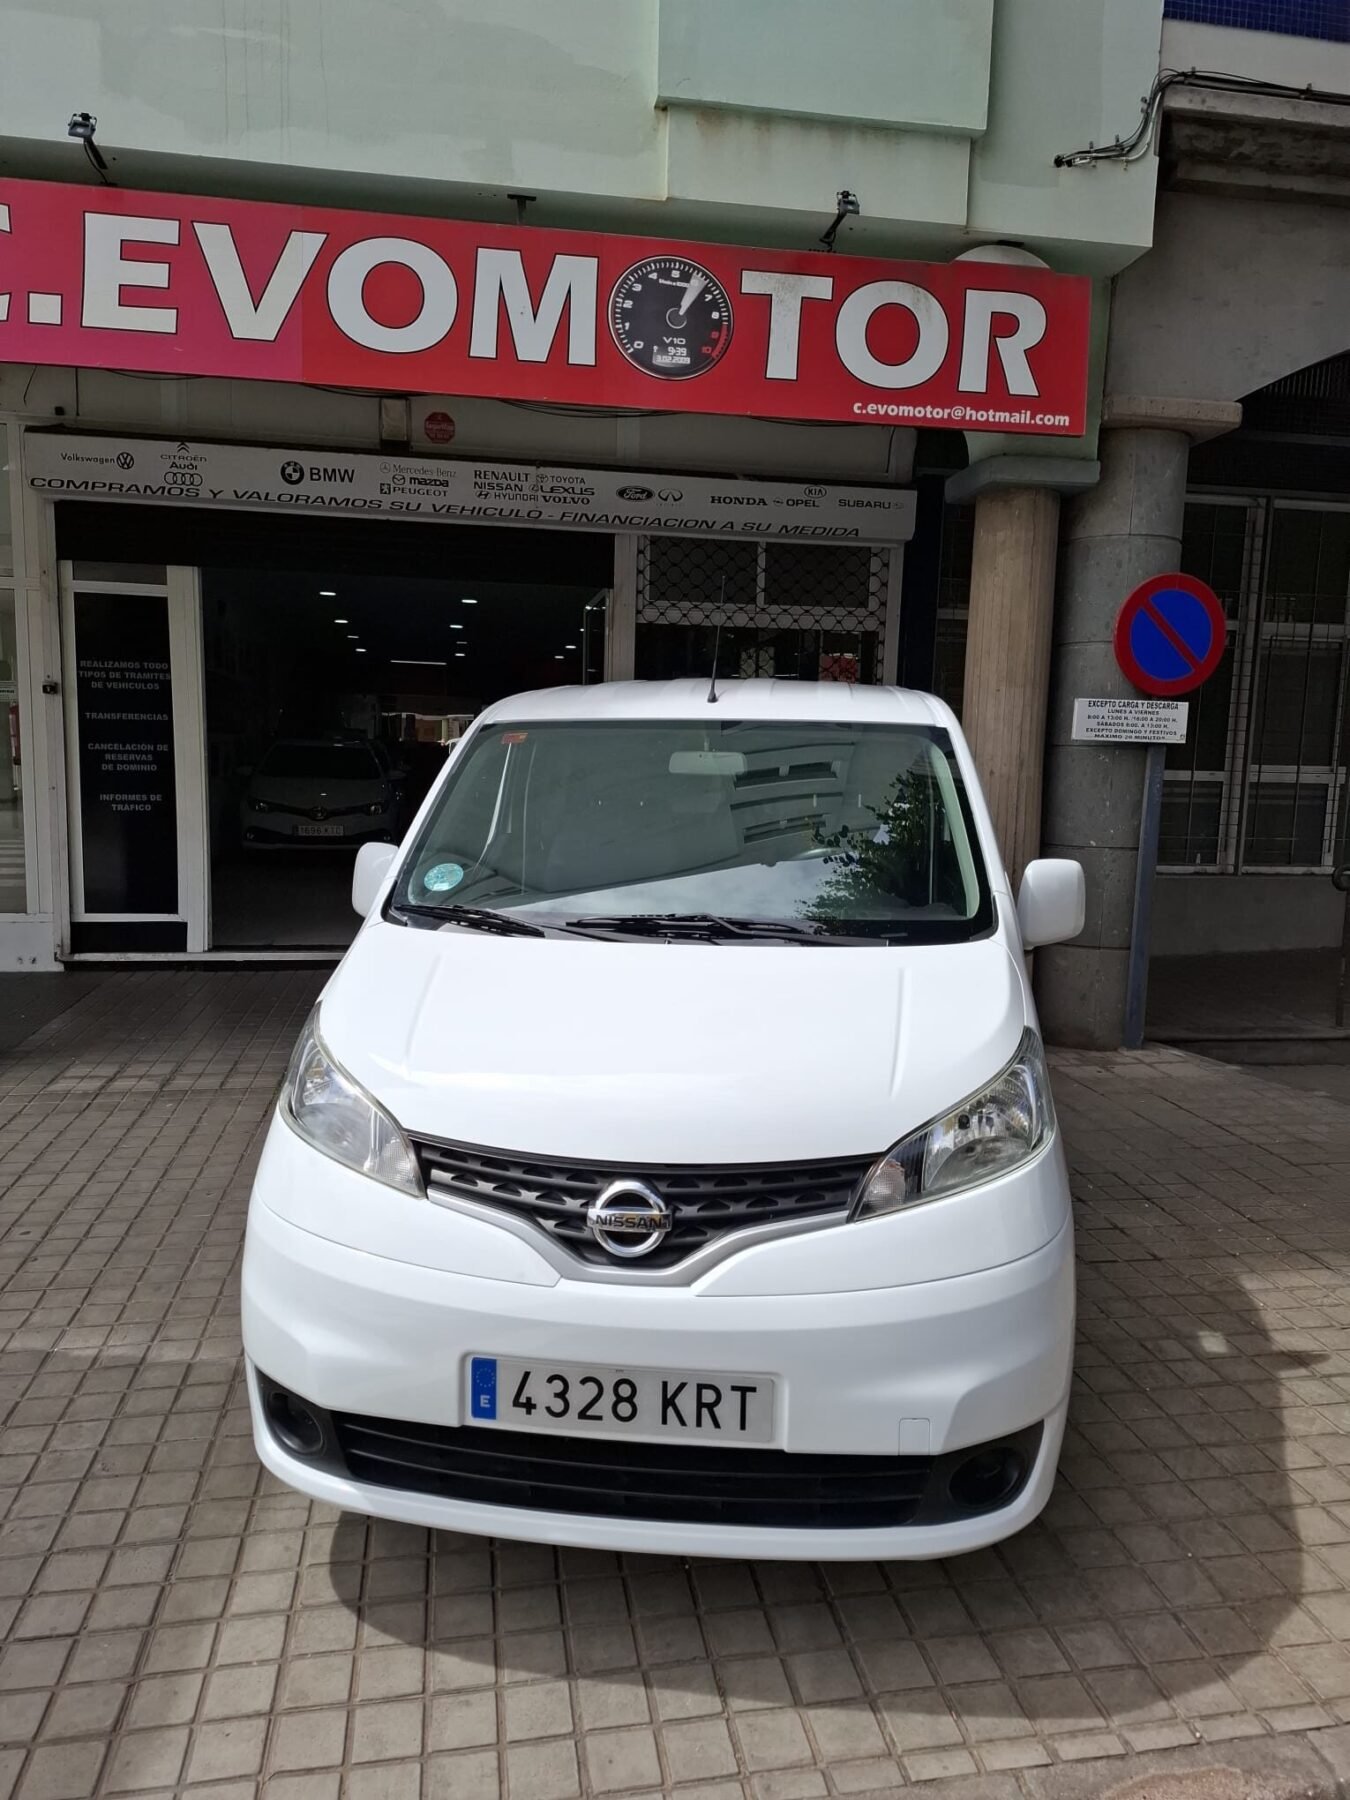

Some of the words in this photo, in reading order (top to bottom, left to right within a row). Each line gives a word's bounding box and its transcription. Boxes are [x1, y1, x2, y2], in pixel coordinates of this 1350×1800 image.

[632, 284, 642, 292] 3
[623, 300, 633, 308] 2
[633, 341, 644, 349] 0
[662, 336, 686, 345] V10
[853, 401, 1070, 427] c.evomotor@hotmail.com
[61, 452, 115, 465] Volkswagen
[309, 467, 355, 483] BMW
[474, 470, 530, 482] RENAULT
[549, 475, 586, 484] TOYOTA
[393, 486, 448, 496] PEUGEOT
[473, 481, 523, 492] NISSAN
[540, 485, 595, 495] LEXUS
[494, 492, 538, 502] HYUNDAI
[541, 495, 590, 505] VOLVO
[710, 496, 768, 506] HONDA
[30, 477, 200, 498] COMPRAMOS
[209, 489, 223, 499] Y
[232, 490, 383, 509] VALORAMOS
[389, 501, 421, 511] SU
[431, 503, 543, 519] VEHICULO
[560, 511, 716, 530] FINANCIACION
[719, 521, 735, 530] A
[741, 522, 772, 532] SU
[778, 524, 860, 537] MEDIDA
[786, 498, 820, 508] OPEL
[838, 499, 891, 509] SUBARU
[80, 660, 140, 669] REALIZAMOS
[78, 670, 106, 678] TIPOS
[109, 671, 121, 679] DE
[1088, 700, 1116, 708] EXCEPTO
[1118, 700, 1139, 708] CARGA
[1146, 702, 1178, 710] DESCARGA
[84, 712, 168, 720] TRANSFERENCIAS
[157, 743, 169, 751] DE
[104, 753, 153, 761] RESERVAS
[101, 763, 114, 771] DE
[116, 763, 157, 771] DOMINIO
[100, 793, 148, 801] INFORMES
[150, 793, 162, 801] DE
[595, 1214, 662, 1229] NISSAN
[480, 1395, 491, 1408] E
[511, 1371, 639, 1423] 4328
[661, 1381, 758, 1431] KRT
